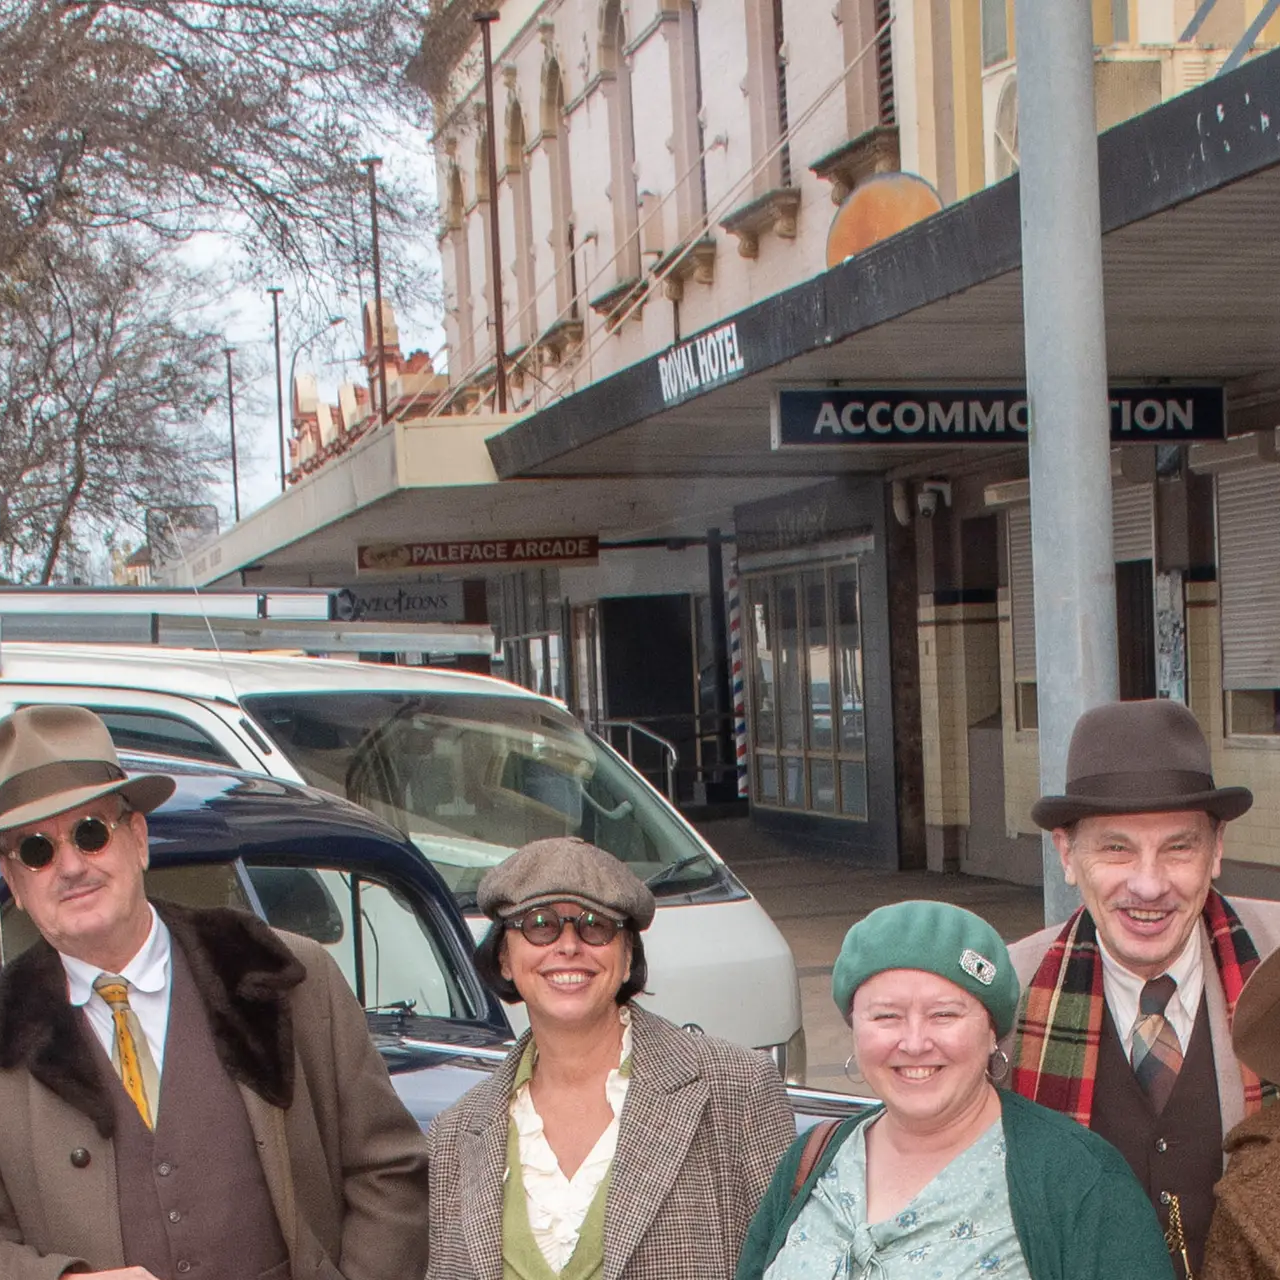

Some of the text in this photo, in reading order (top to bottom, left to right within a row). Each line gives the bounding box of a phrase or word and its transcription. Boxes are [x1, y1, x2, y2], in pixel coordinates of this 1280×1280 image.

[658, 322, 744, 402] ROYAL HOTEL
[813, 399, 1193, 435] ACCOMMOION
[412, 539, 590, 562] PALEFACE ARCADE
